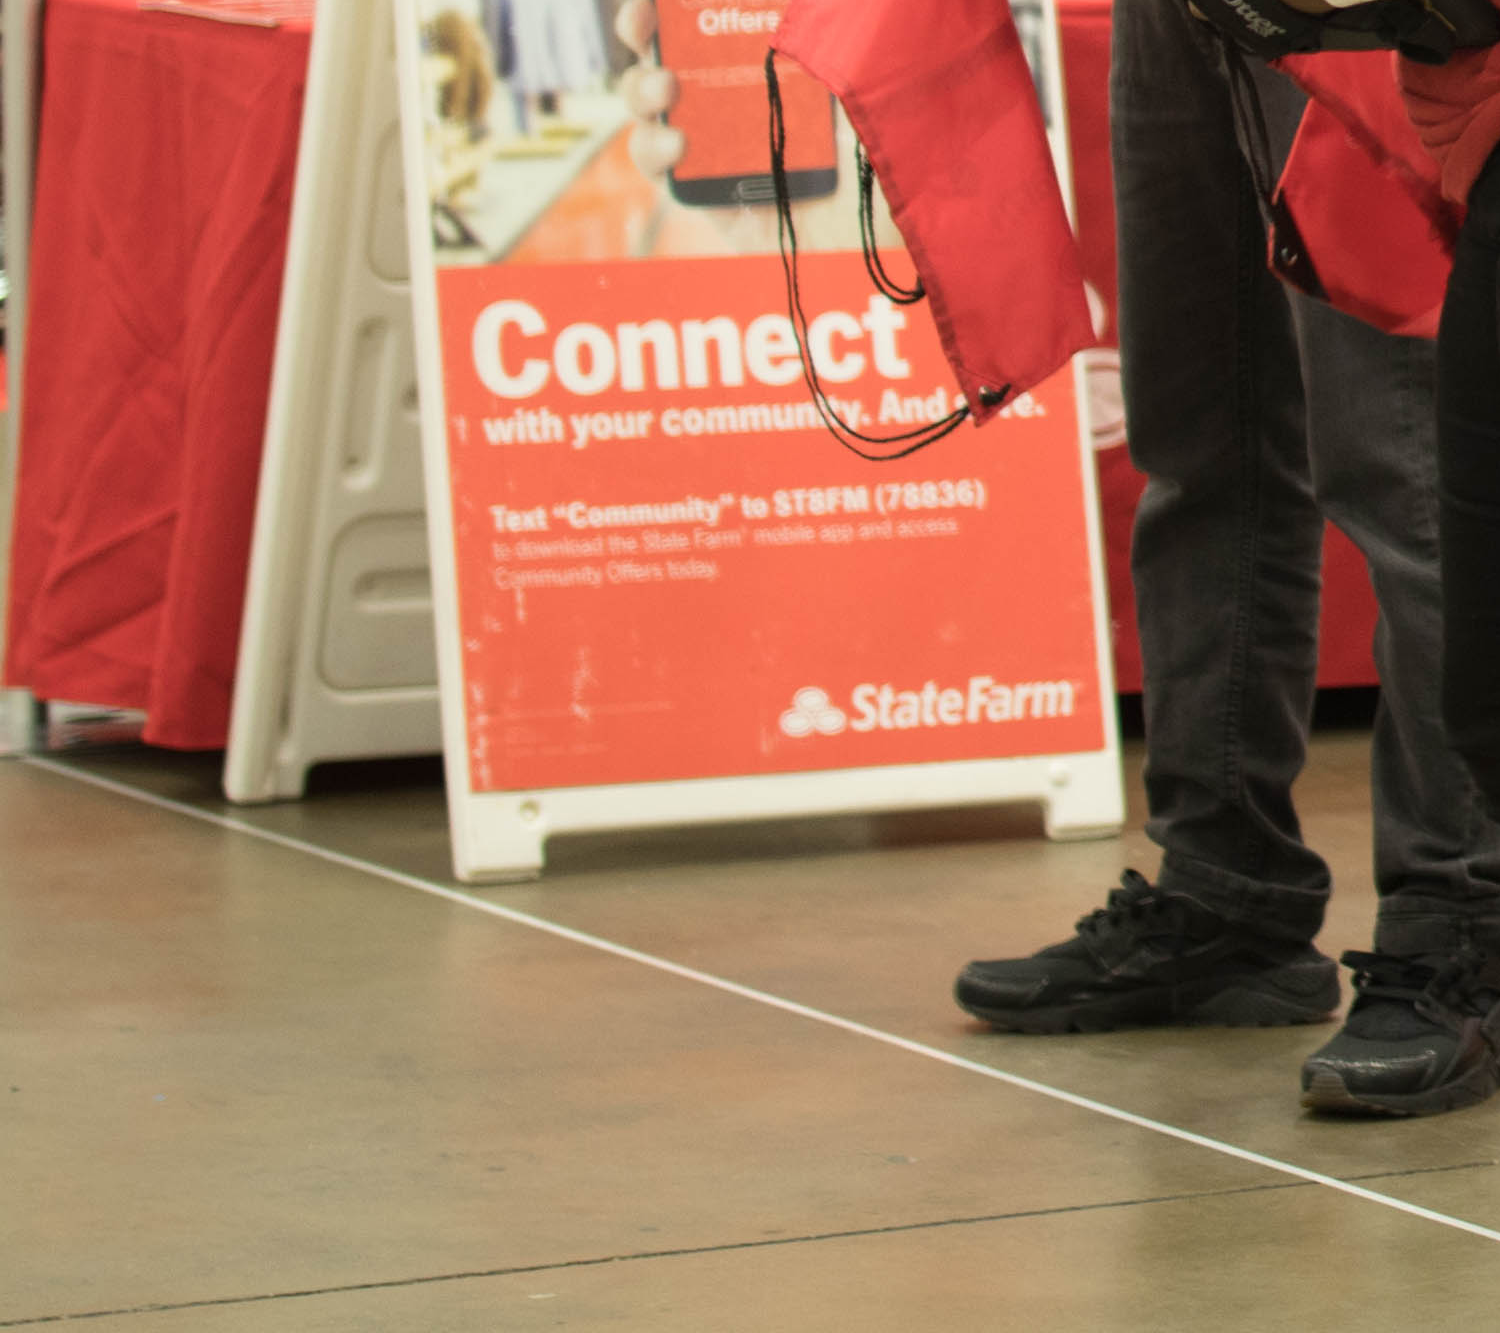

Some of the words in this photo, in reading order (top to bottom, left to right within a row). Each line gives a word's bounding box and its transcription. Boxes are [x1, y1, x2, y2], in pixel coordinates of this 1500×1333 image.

[697, 8, 781, 36] Offers
[471, 294, 911, 399] Connect
[482, 406, 565, 445] with
[570, 410, 655, 449] your
[660, 395, 872, 437] community.
[878, 387, 948, 425] And
[490, 503, 549, 532] Text
[741, 494, 769, 519] to
[772, 485, 870, 517] ST8FM
[875, 478, 987, 515] (78836)
[515, 535, 604, 561] download
[608, 533, 638, 554] the
